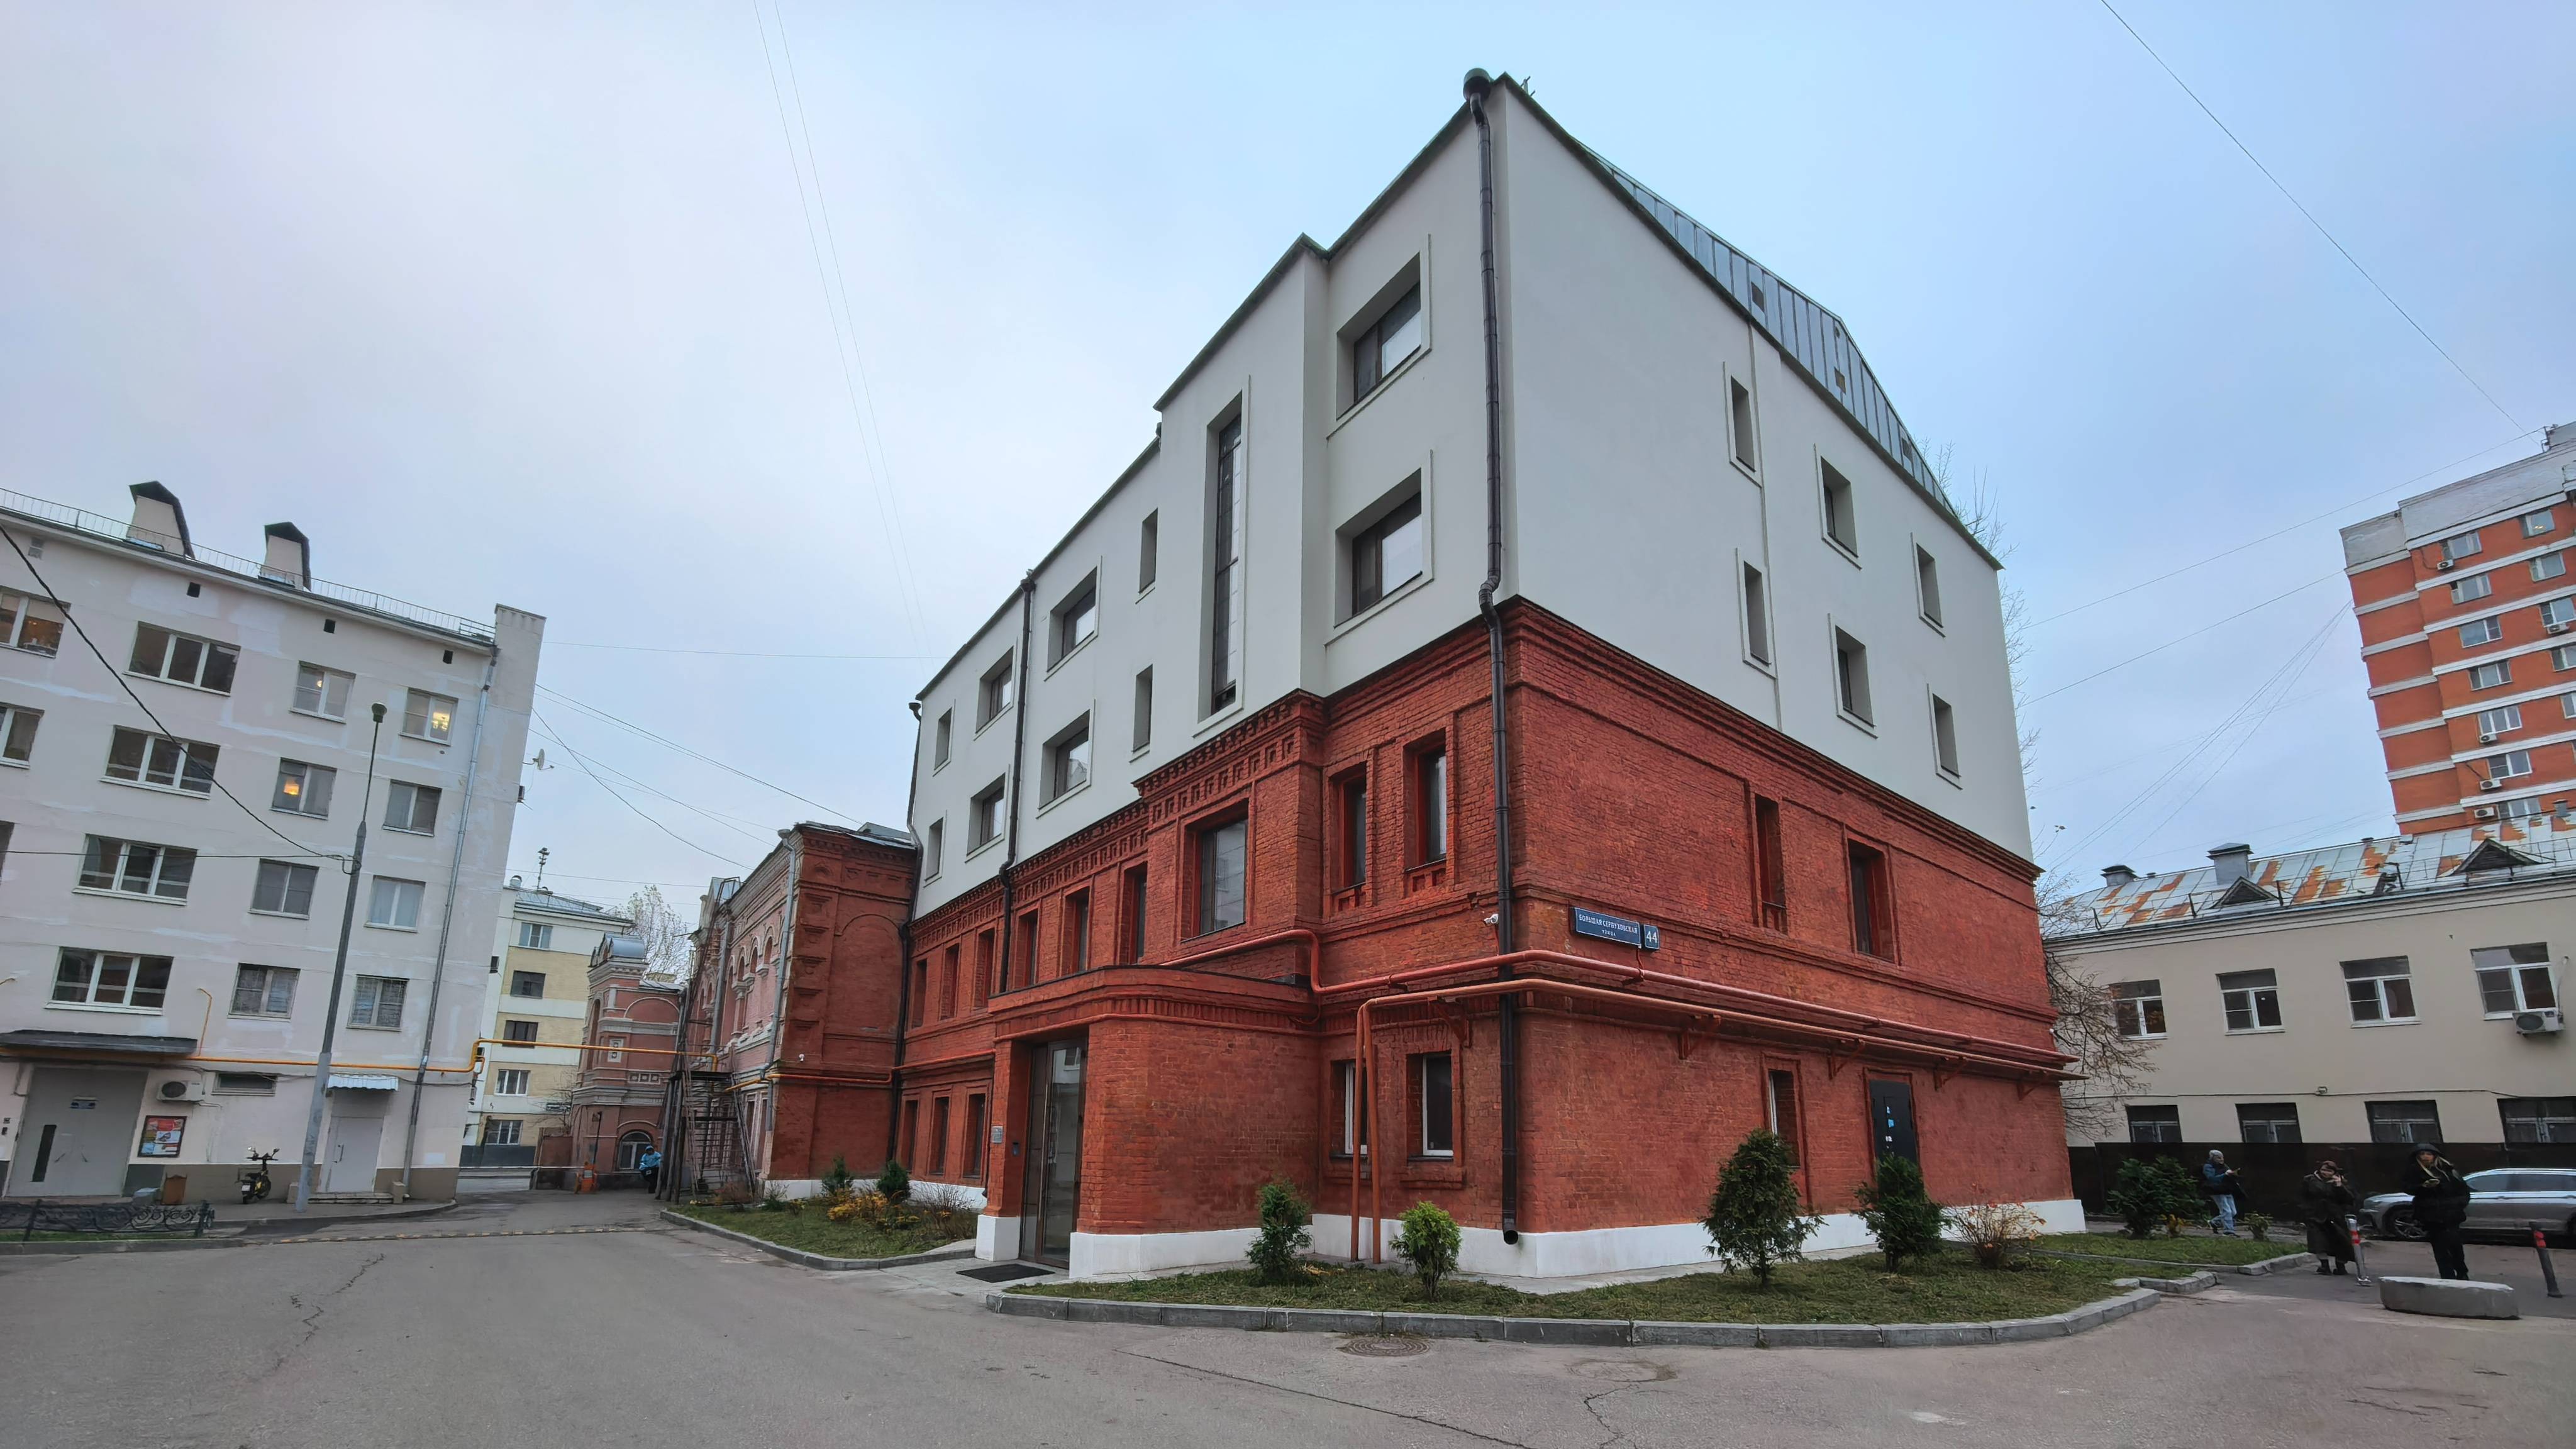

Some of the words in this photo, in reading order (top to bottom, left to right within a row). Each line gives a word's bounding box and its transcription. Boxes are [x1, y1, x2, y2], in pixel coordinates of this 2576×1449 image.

[1579, 914, 1602, 926] БОЛЬШАЯ
[1603, 920, 1638, 934] СЕРПУХОВСКАЯ
[1646, 931, 1658, 943] 44
